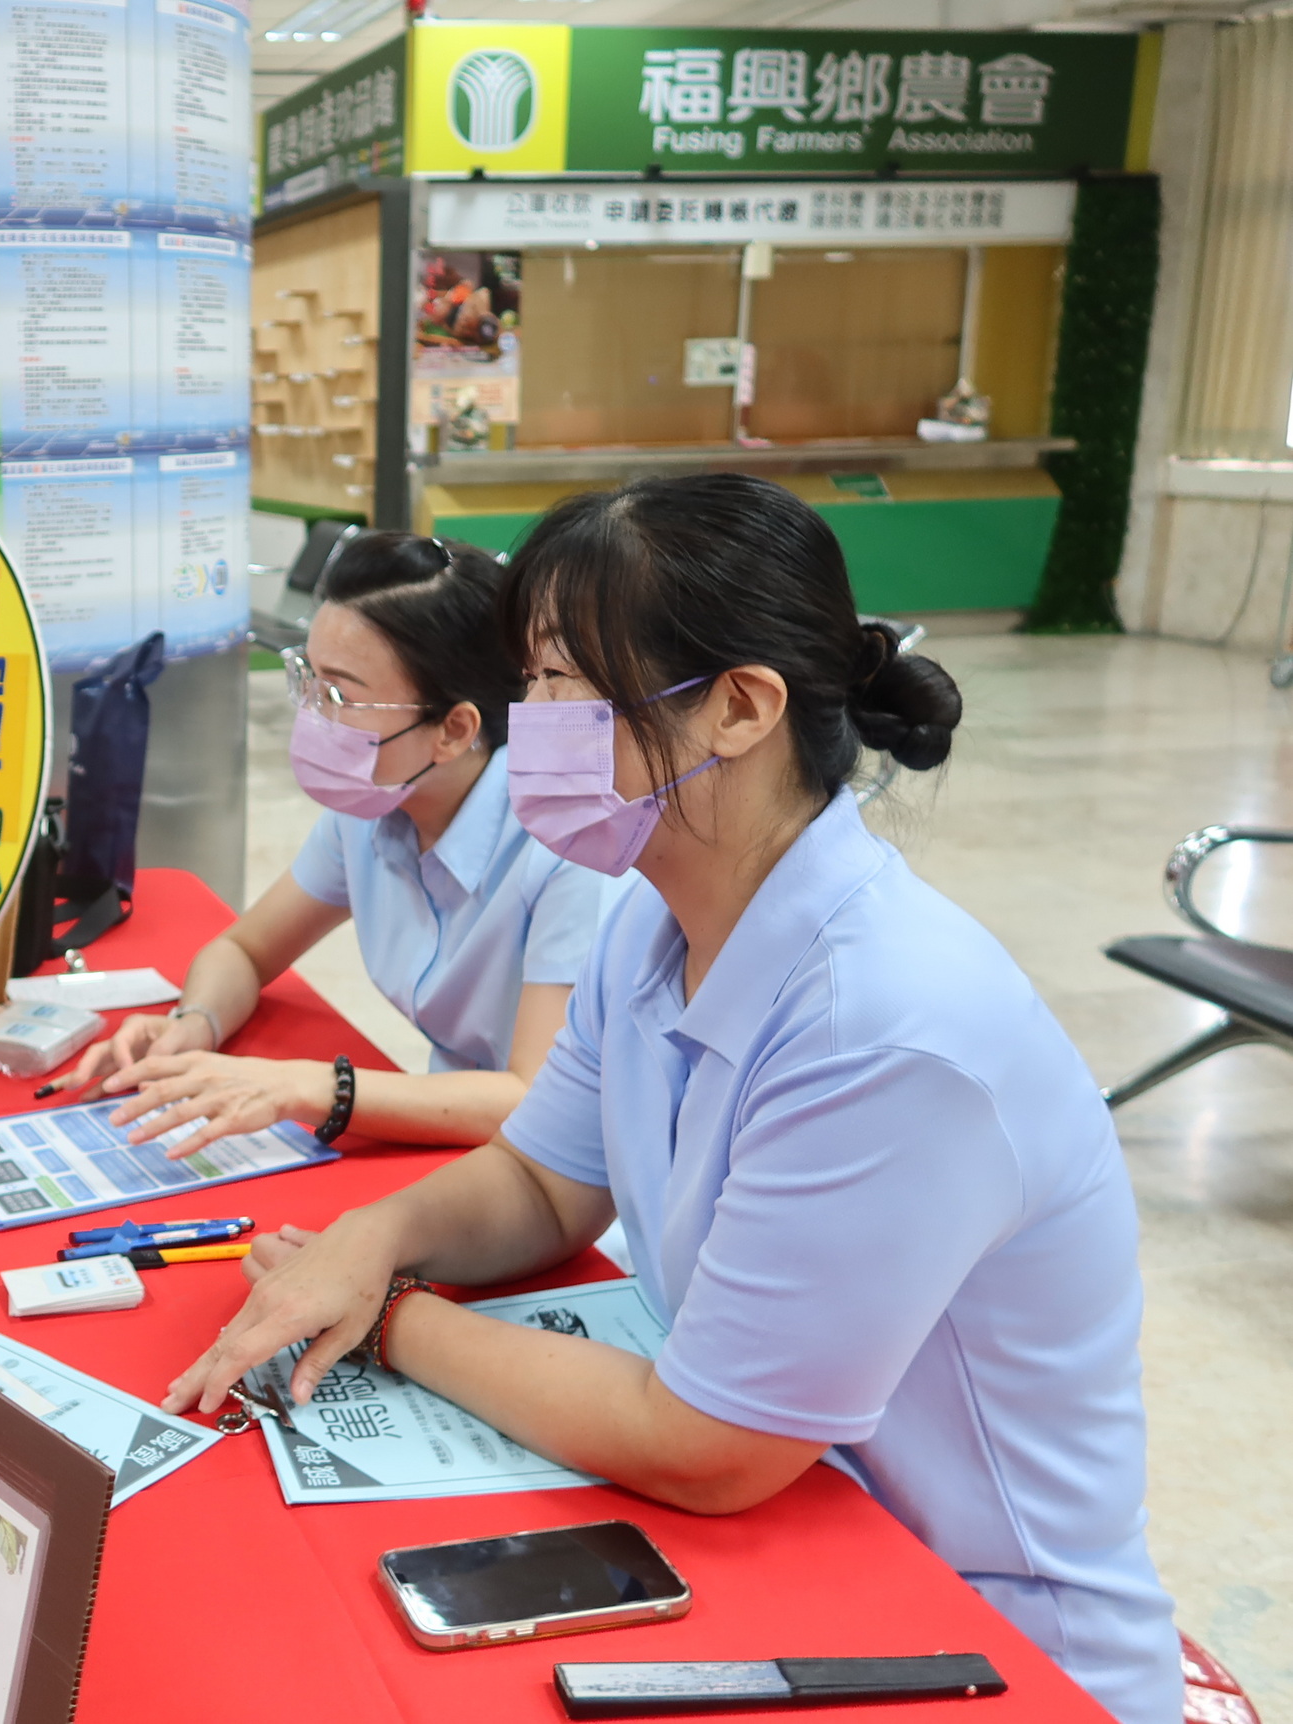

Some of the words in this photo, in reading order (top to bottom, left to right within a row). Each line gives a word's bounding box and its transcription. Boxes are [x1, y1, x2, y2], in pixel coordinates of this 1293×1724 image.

[639, 48, 1054, 124] 福興鄉農會
[652, 126, 744, 158] Fusing
[888, 127, 1034, 153] Association
[293, 1445, 342, 1488] 誠徵
